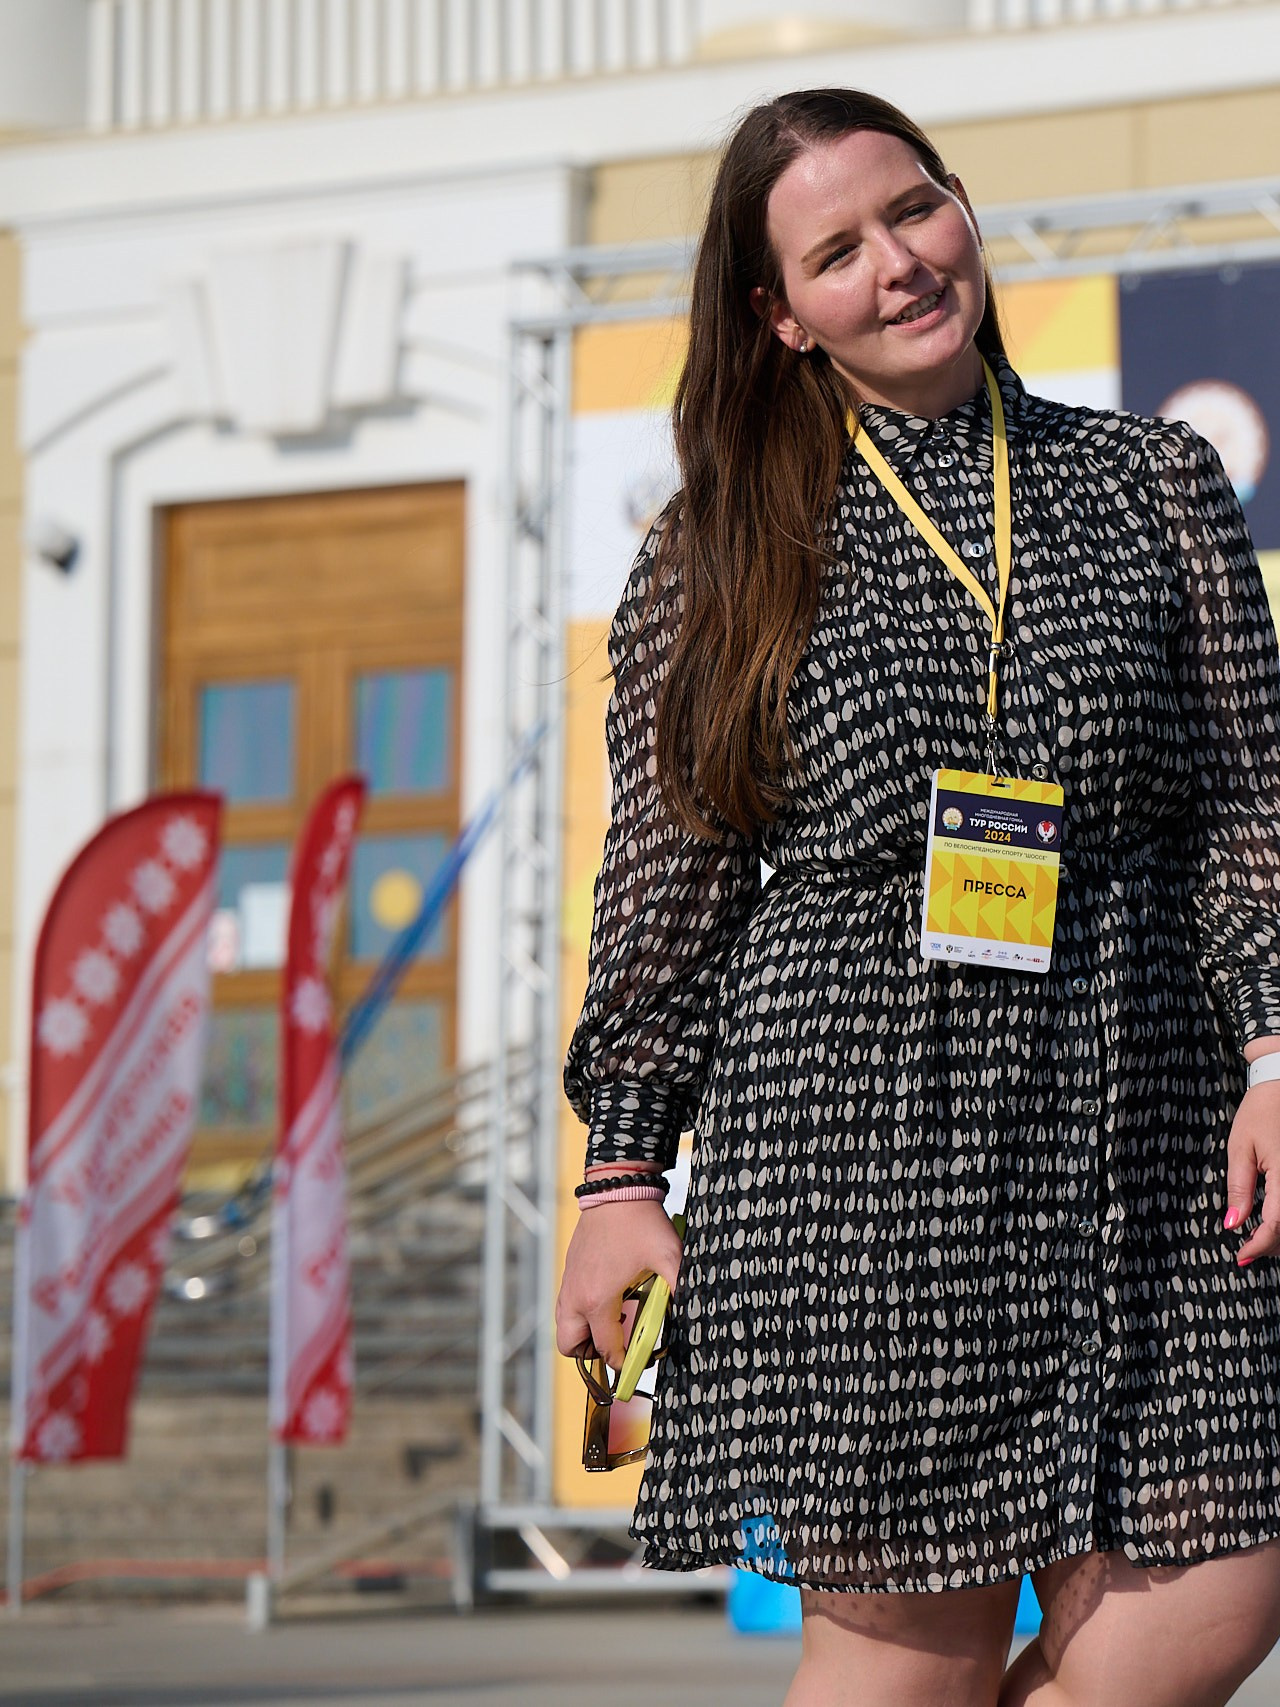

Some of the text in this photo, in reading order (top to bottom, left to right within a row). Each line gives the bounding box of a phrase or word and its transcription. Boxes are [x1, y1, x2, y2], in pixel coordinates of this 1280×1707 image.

[974, 812, 1009, 822] МНОГОДНЕВНАЯ
[980, 808, 1019, 818] МЕЖДУНАРОДНАЯ
[969, 817, 1028, 834] ТУР РОССИИ
[984, 829, 1012, 843] 2024
[953, 842, 1001, 855] ВЕЛОСИПЕДНОМУ
[1001, 849, 1024, 858] СПОРТУ
[1023, 852, 1048, 861] "ШОССЕ"
[963, 879, 1027, 899] ПРЕССА
